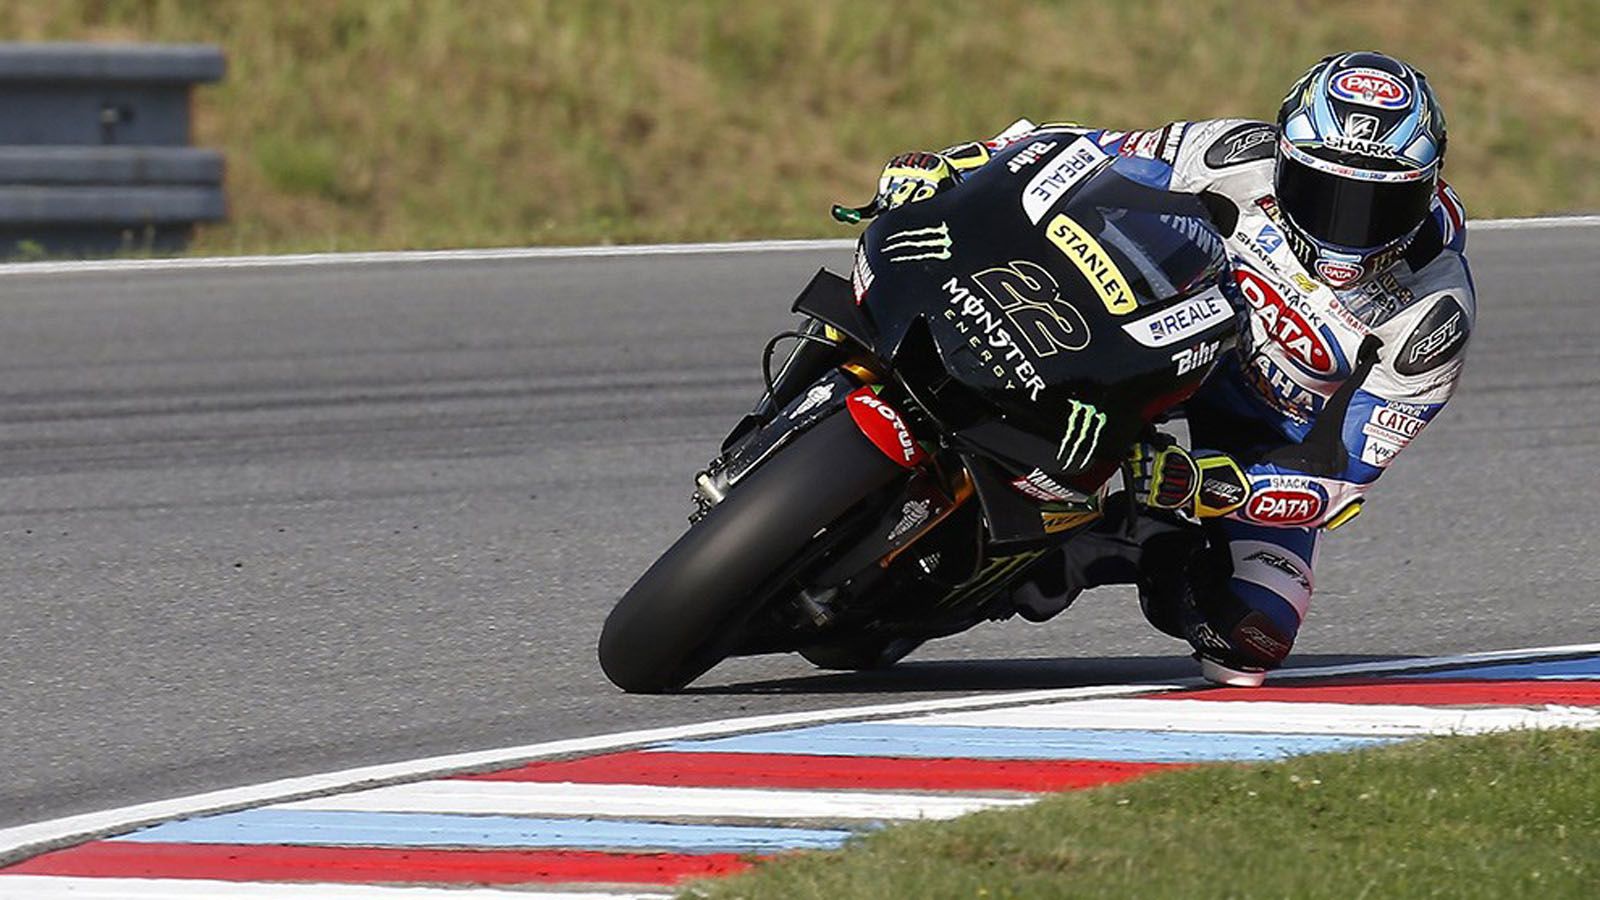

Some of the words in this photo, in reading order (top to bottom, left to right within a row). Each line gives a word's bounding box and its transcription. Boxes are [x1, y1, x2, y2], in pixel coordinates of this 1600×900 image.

[1346, 78, 1394, 96] PATA
[1006, 140, 1058, 174] Bihr
[1325, 137, 1395, 157] SHARK
[1031, 156, 1086, 202] REALE
[1053, 225, 1129, 306] STANLEY
[1235, 232, 1280, 275] SHARK
[970, 260, 1092, 358] 22
[1163, 297, 1221, 334] REALE
[1240, 277, 1314, 365] PATA
[941, 277, 1046, 401] MONSTER
[944, 309, 1016, 390] ENERGY
[1171, 341, 1220, 376] Bihr
[1409, 311, 1460, 364] RST
[854, 395, 915, 461] MOTUL
[1254, 496, 1310, 518] PATA
